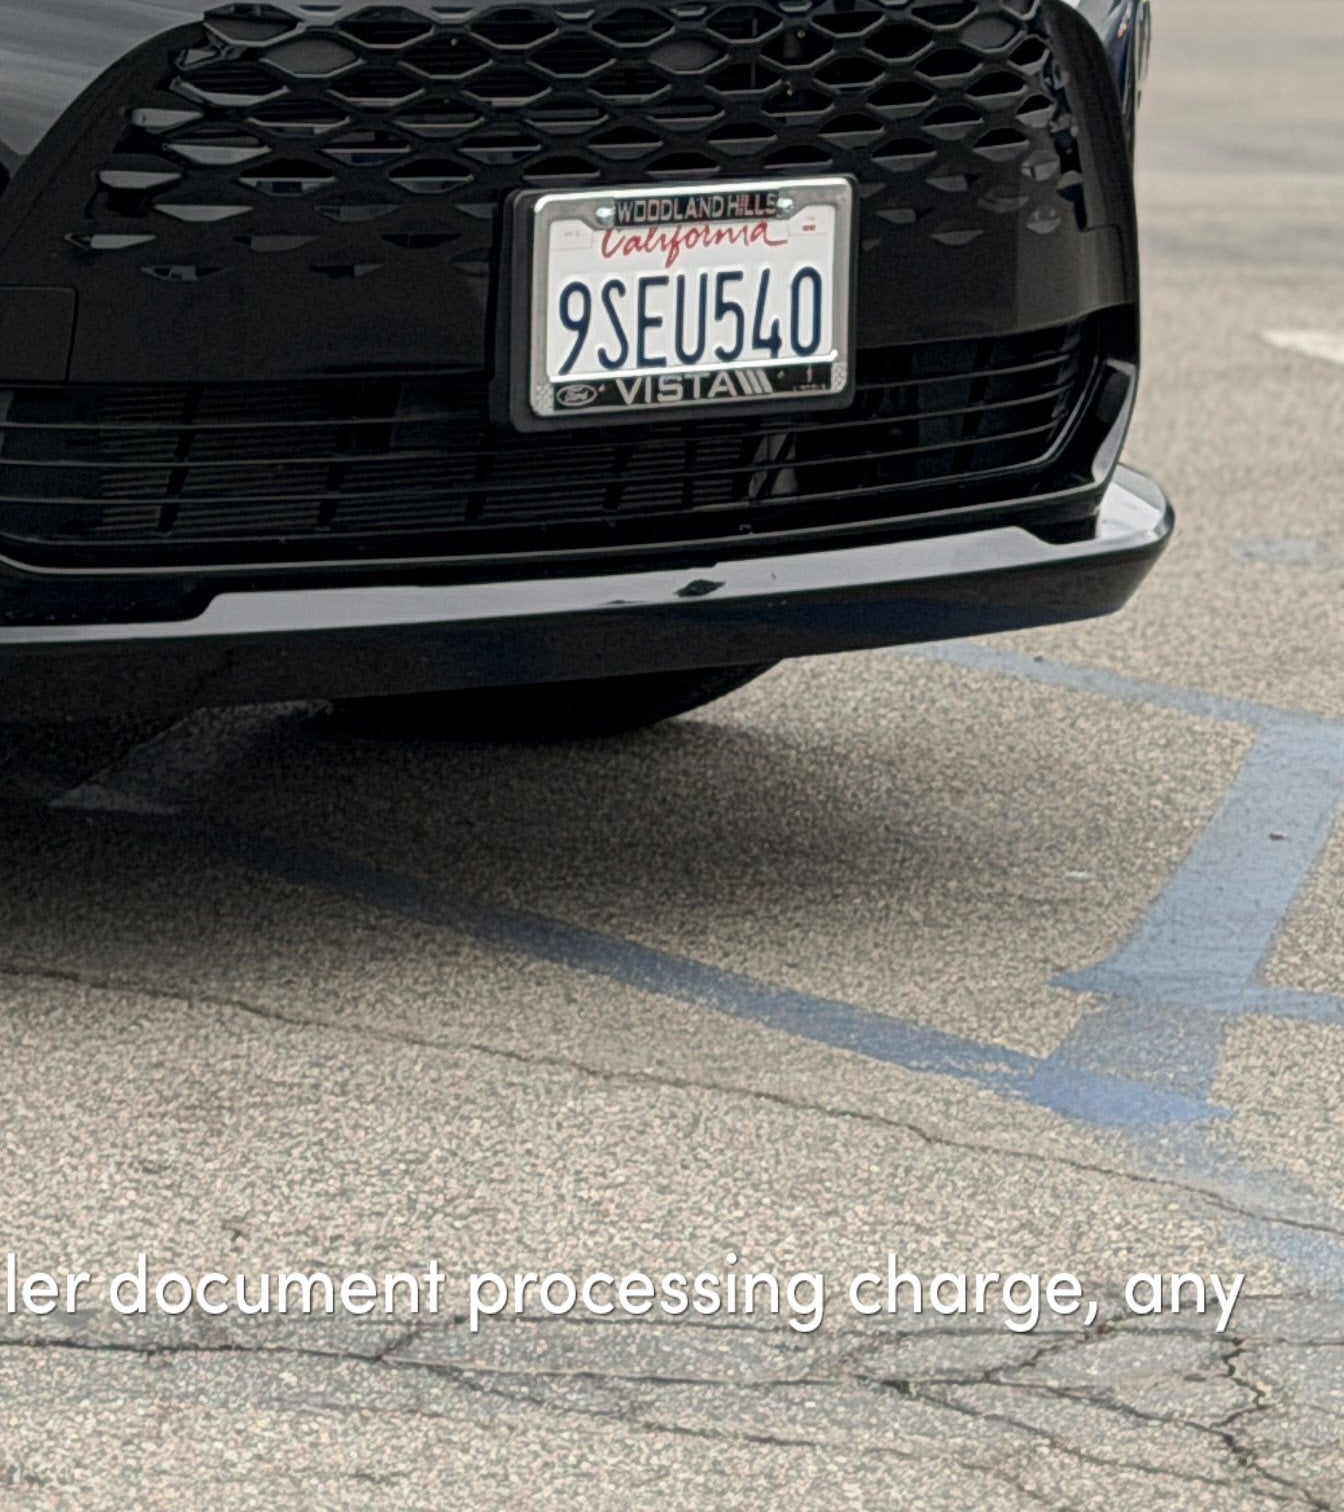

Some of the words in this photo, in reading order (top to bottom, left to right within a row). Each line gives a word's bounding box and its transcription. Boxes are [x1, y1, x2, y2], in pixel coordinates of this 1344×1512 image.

[615, 195, 725, 223] WOODLAND
[729, 193, 778, 218] HILLS
[600, 220, 789, 269] California
[557, 266, 824, 376] 9SEU540
[615, 371, 737, 405] VISTA
